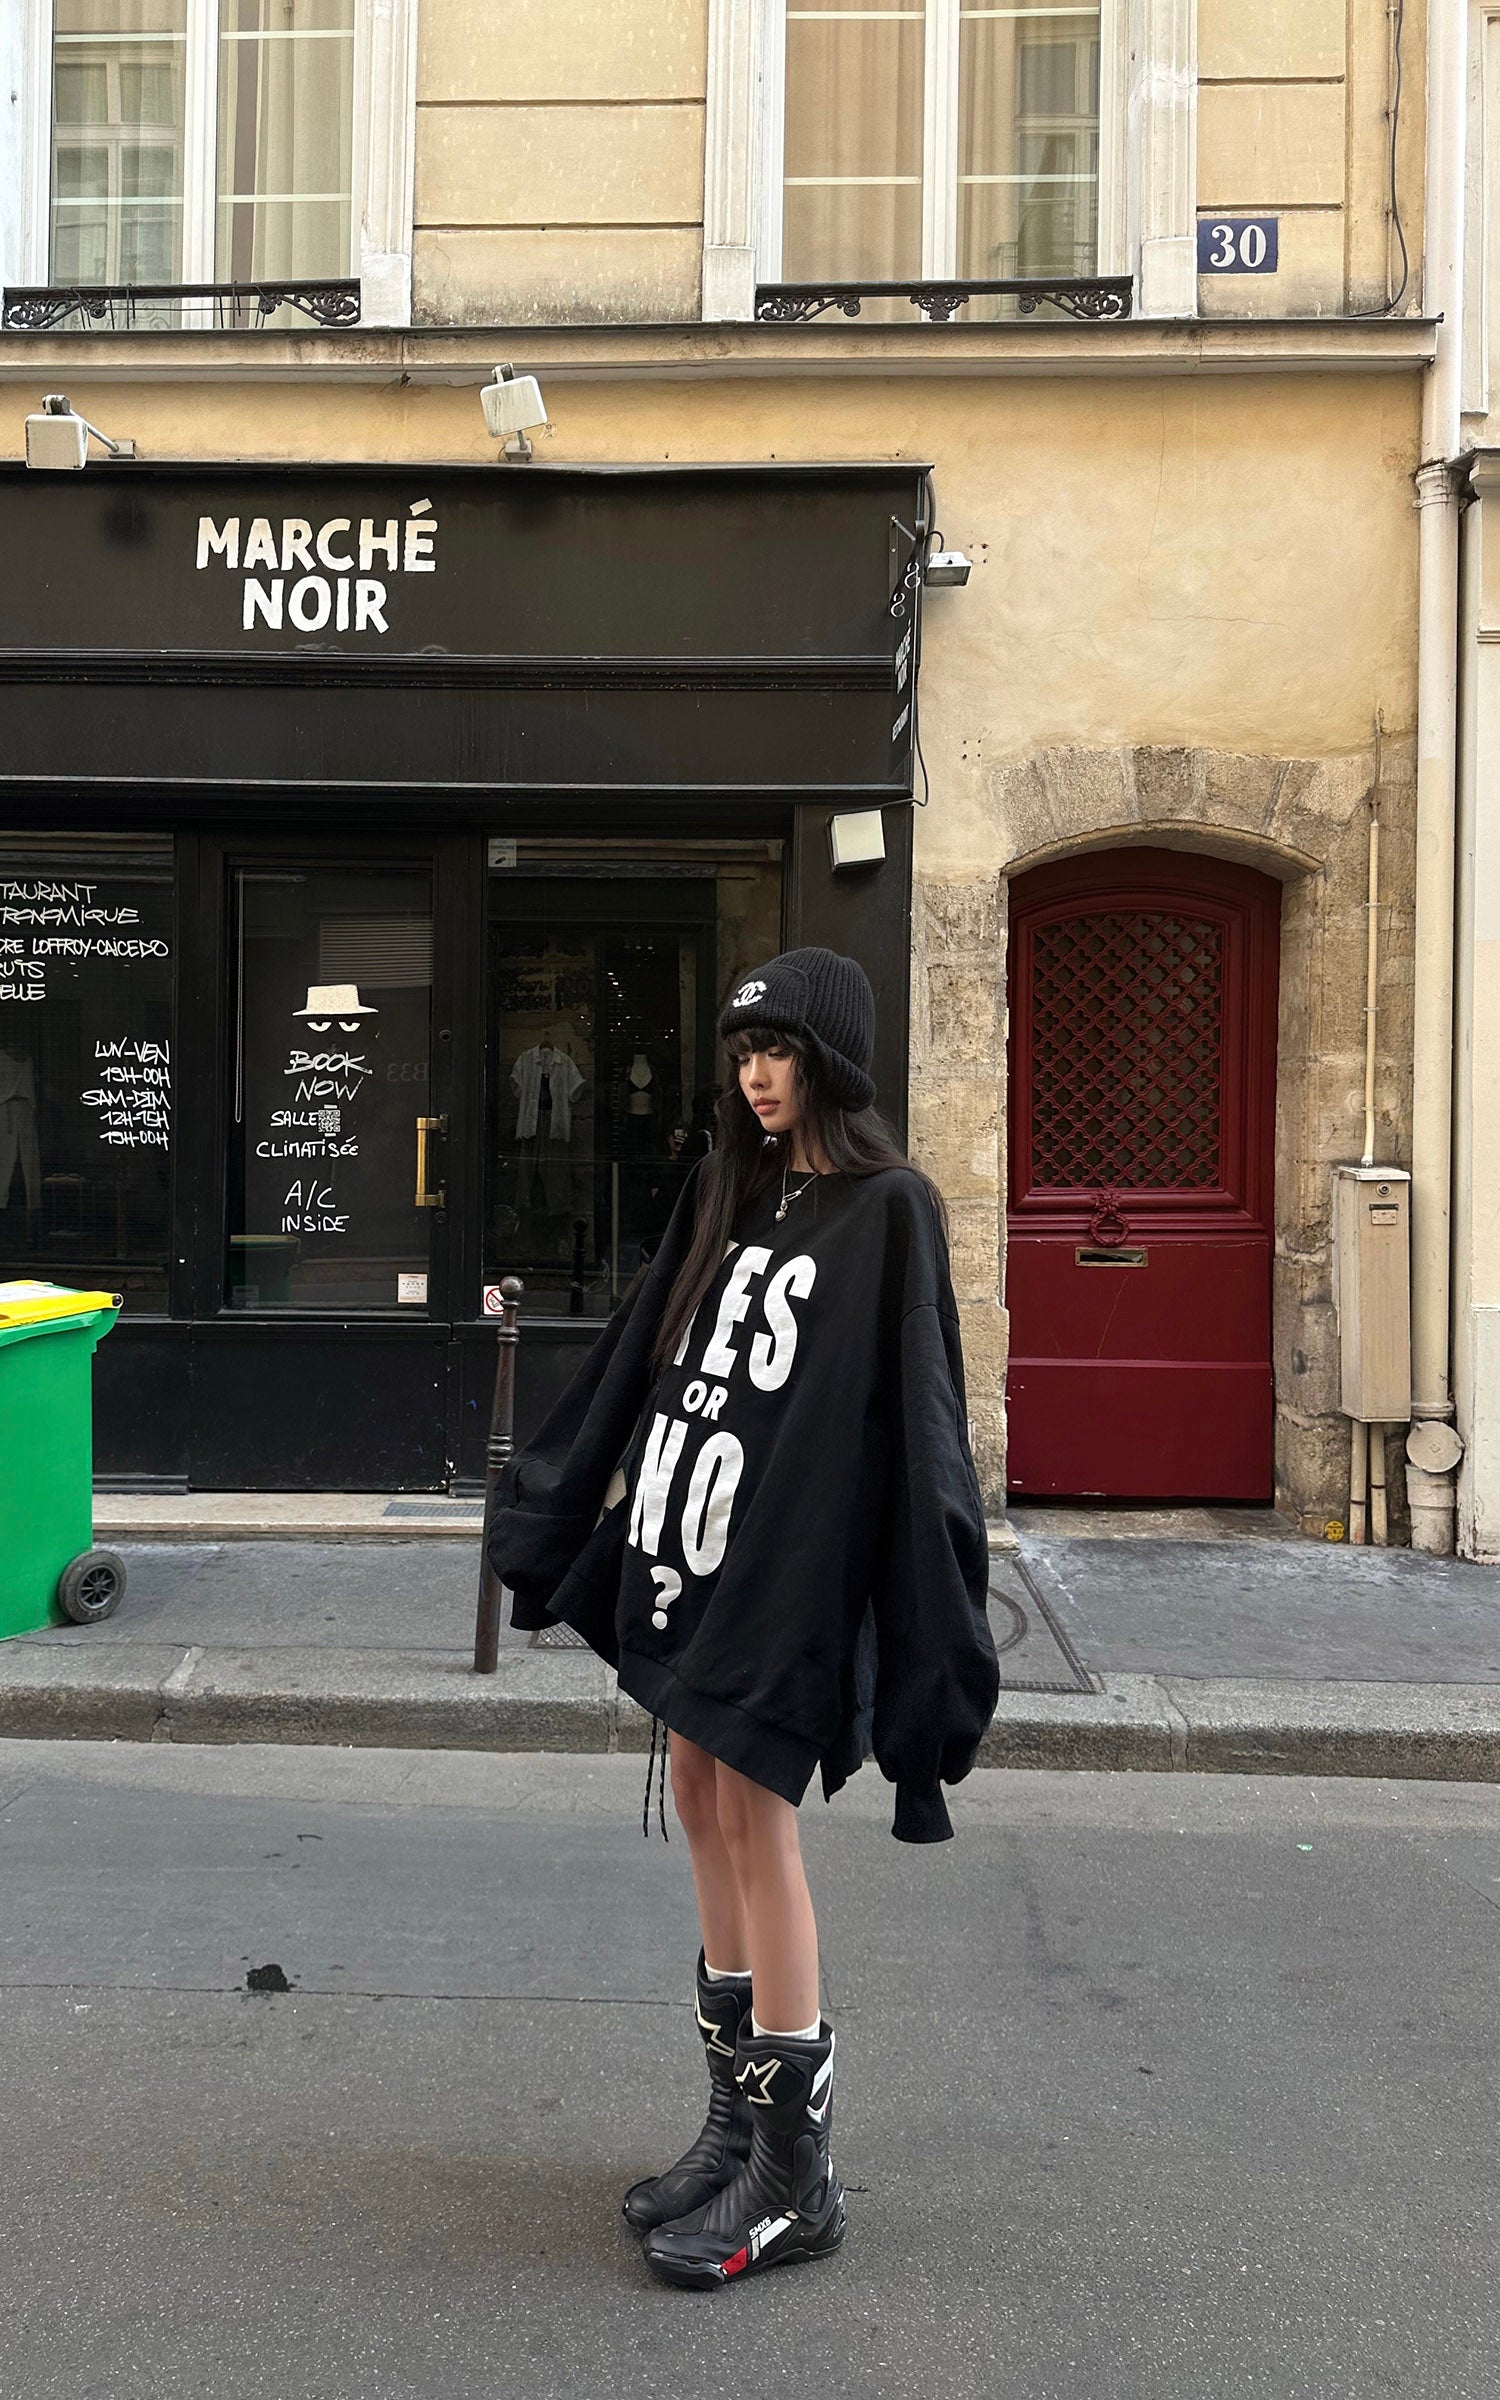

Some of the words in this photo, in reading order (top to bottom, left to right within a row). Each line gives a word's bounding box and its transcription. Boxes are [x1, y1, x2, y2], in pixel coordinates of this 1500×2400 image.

[1211, 225, 1266, 267] 30
[197, 498, 437, 571] MARCHÉ
[243, 575, 389, 633] NOIR
[95, 1037, 169, 1064] LUN-VEN
[284, 1051, 372, 1077] BOOK
[100, 1065, 171, 1089] 19H-00H
[295, 1077, 363, 1102] NOW
[82, 1088, 171, 1110] SAM-DIM
[271, 1111, 318, 1127] SALLE
[285, 1180, 335, 1210] A/C
[282, 1214, 349, 1232] INSIDE
[674, 1241, 816, 1392] ES
[682, 1380, 728, 1421] OR
[628, 1412, 744, 1577] NO
[650, 1565, 683, 1630] ?
